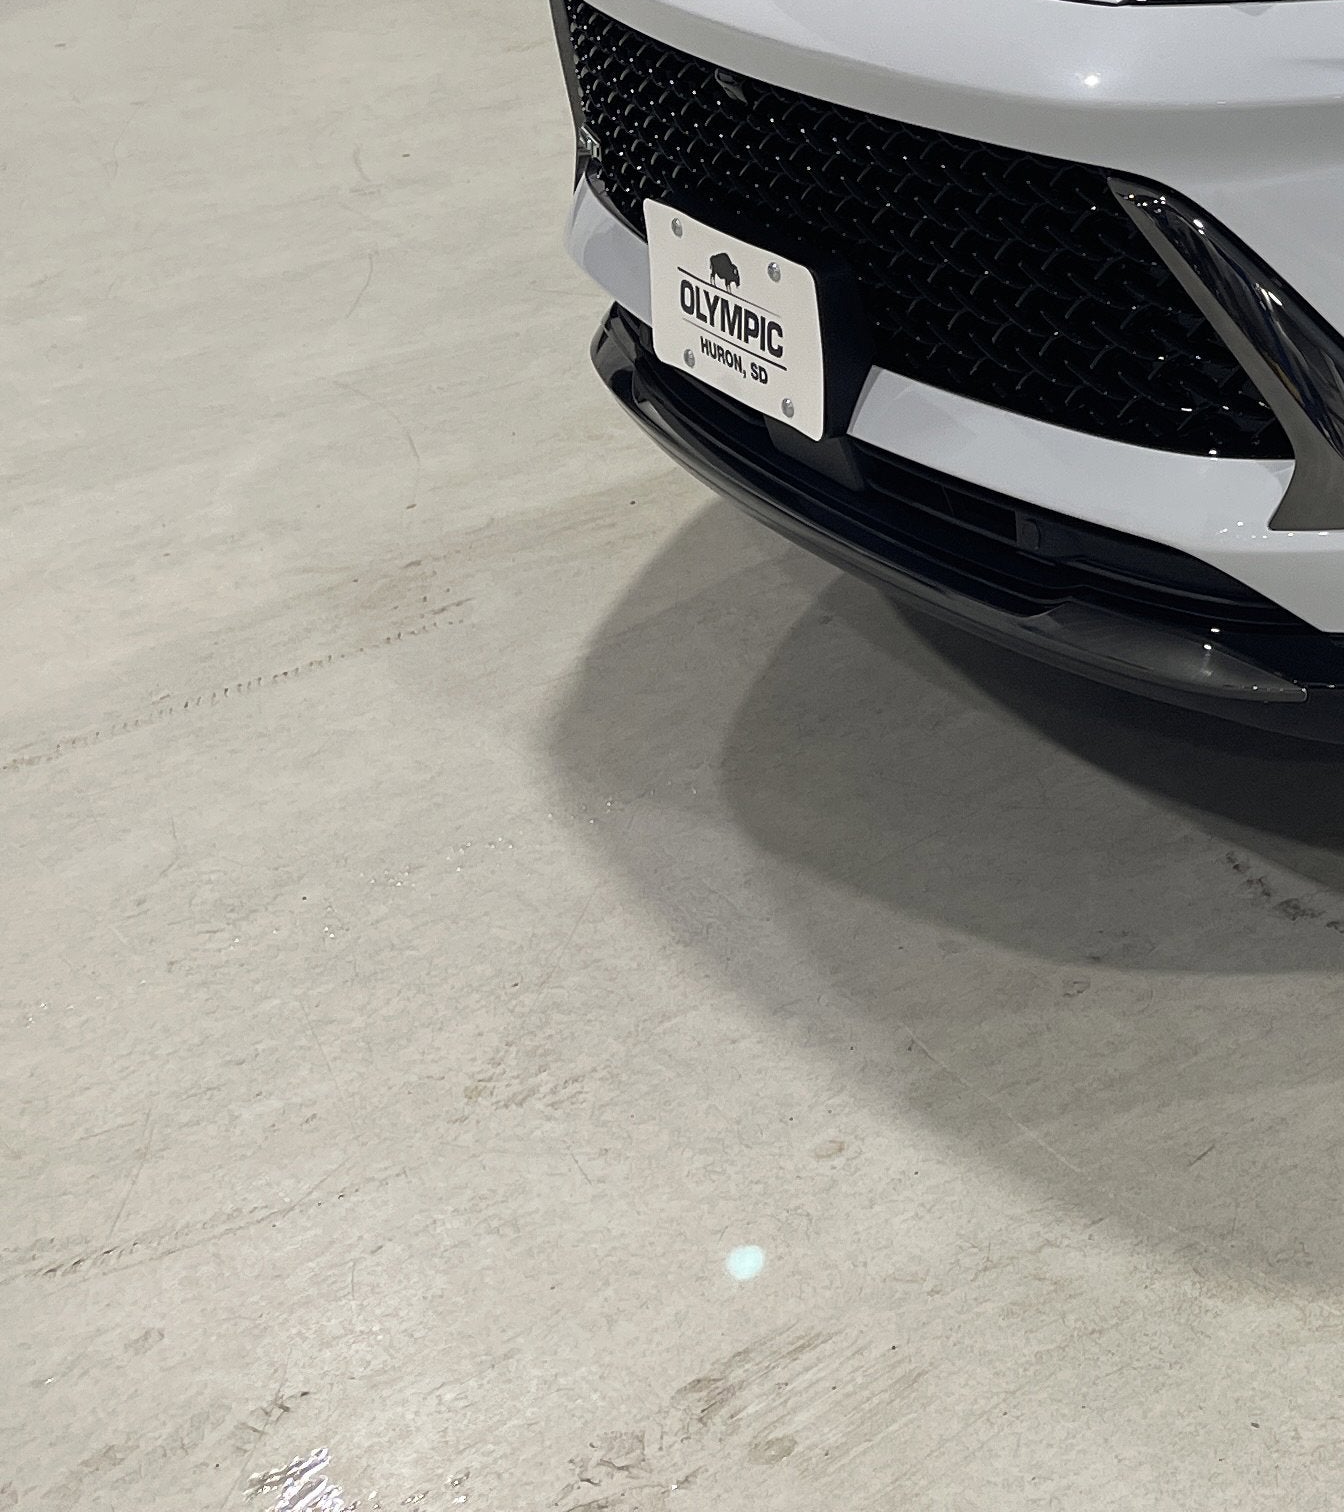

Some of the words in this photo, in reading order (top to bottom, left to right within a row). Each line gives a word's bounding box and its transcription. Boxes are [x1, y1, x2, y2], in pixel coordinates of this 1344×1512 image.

[680, 280, 784, 358] OLYMPIC
[700, 336, 747, 379] HURON,
[750, 361, 769, 385] SD
